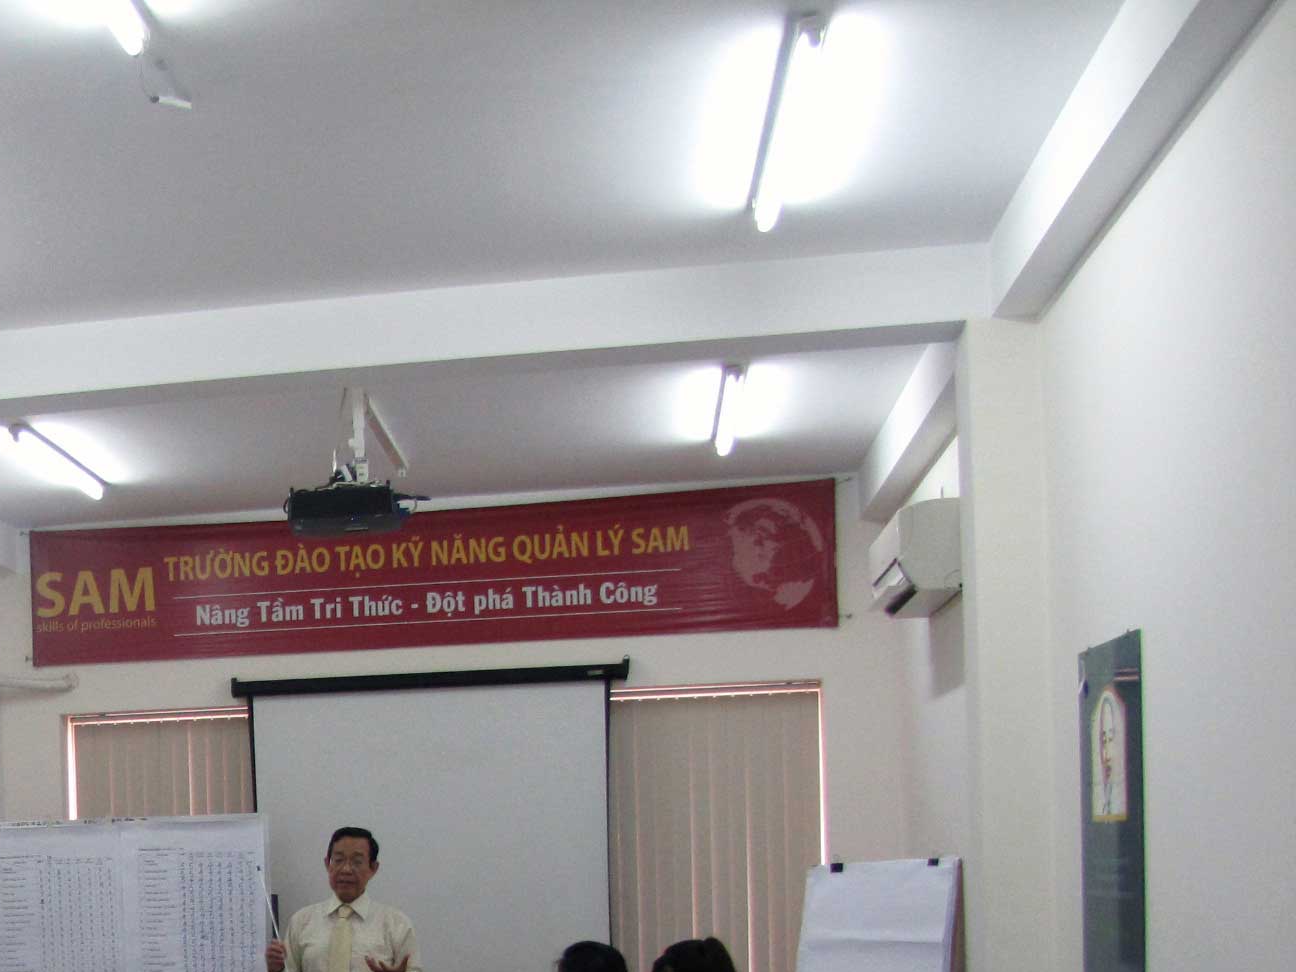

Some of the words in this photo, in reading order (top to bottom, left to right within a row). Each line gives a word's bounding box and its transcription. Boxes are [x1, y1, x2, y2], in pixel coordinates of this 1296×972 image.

[163, 548, 269, 582] TRƯỜNG
[275, 544, 331, 576] ĐÀO
[335, 543, 386, 578] TẠO
[392, 536, 423, 568] KỸ
[431, 533, 506, 567] NĂNG
[512, 524, 589, 564] QUẢN
[596, 524, 625, 557] LÝ
[631, 525, 690, 555] SAM
[35, 566, 156, 618] SAM
[195, 604, 250, 628] Nâng
[310, 597, 342, 620] Tri
[349, 594, 403, 618] Thức
[426, 591, 466, 617] Đột
[474, 587, 514, 615] phá
[522, 583, 592, 608] Thành
[599, 581, 658, 606] Công
[35, 620, 64, 633] skills
[67, 619, 79, 631] of
[81, 616, 158, 632] professionals
